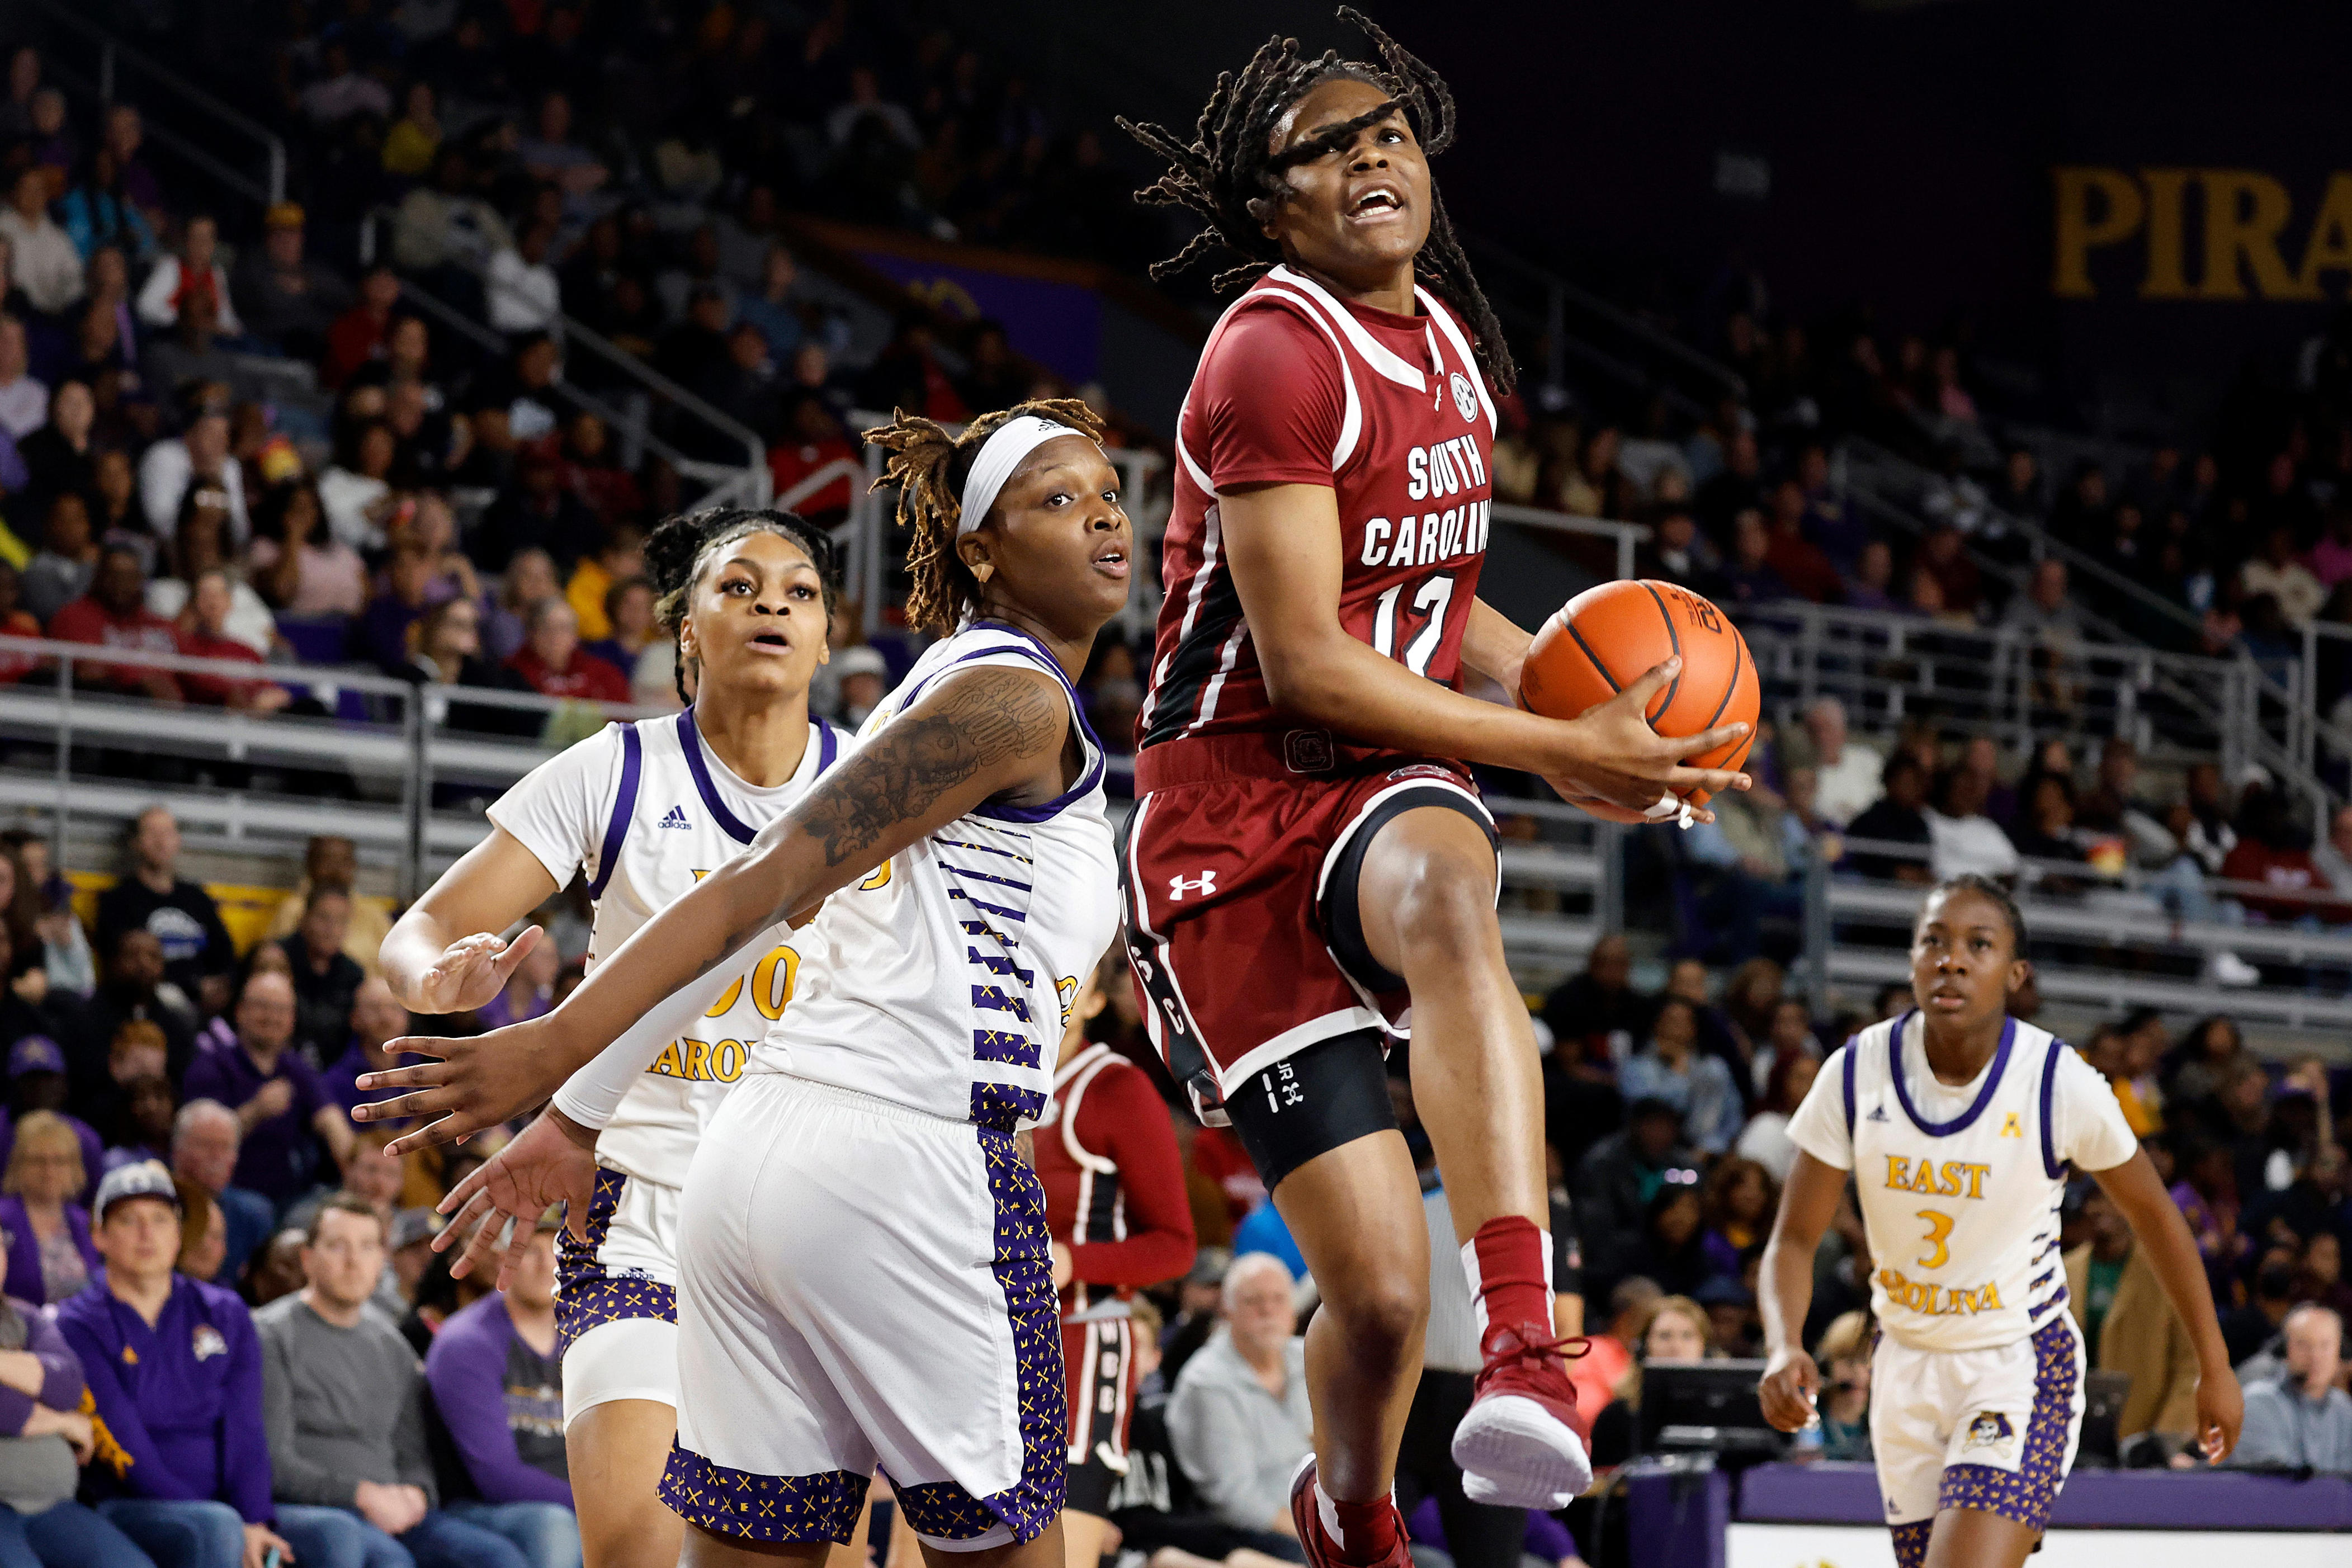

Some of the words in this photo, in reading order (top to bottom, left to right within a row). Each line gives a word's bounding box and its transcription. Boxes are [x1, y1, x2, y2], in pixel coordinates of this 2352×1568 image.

[1407, 433, 1486, 501] SOUTH
[1372, 570, 1456, 689] 12
[658, 818, 692, 830] adidas
[1885, 1154, 1991, 1200] EAST
[1915, 1210, 1955, 1270] 3
